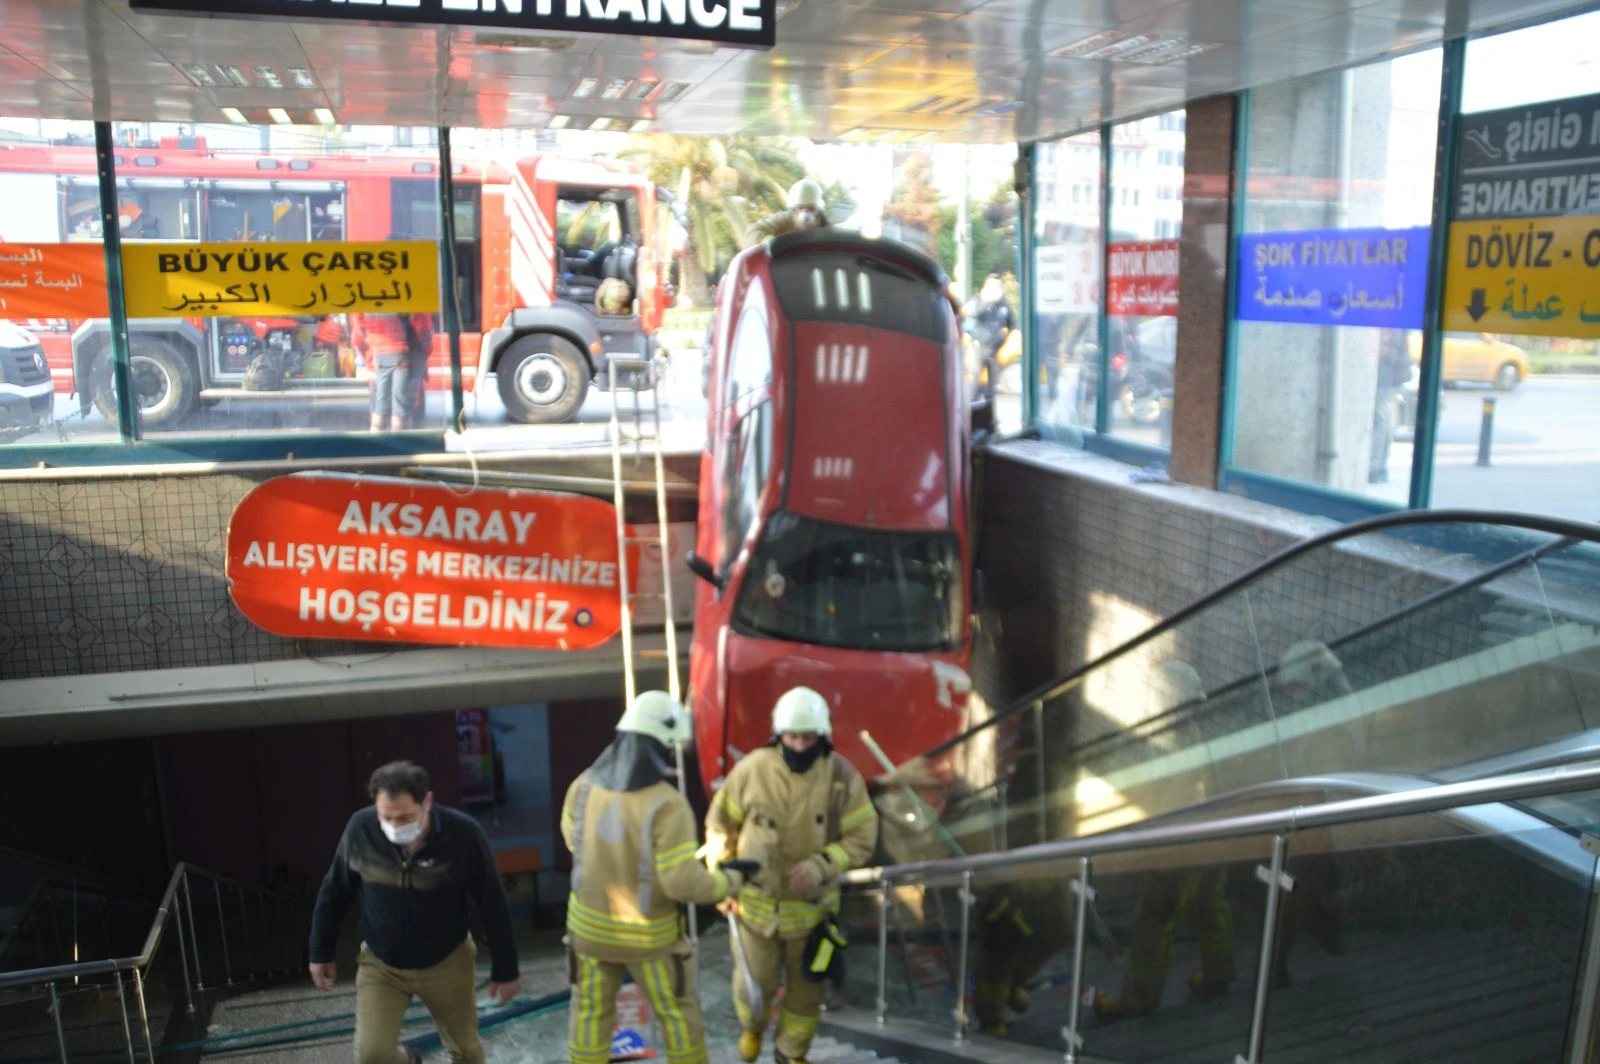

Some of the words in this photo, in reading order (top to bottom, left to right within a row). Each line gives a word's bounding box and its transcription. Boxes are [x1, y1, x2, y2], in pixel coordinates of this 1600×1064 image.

[158, 248, 289, 273] BÜYÜK
[302, 250, 409, 277] ÇARŞI
[1255, 243, 1296, 272] ŞOK
[1301, 234, 1409, 266] FİYATLAR
[1466, 222, 1554, 269] DÖVİZ
[162, 282, 271, 311] الكبير
[292, 280, 412, 308] البازار
[1501, 277, 1565, 321] عملة
[338, 500, 536, 545] AKSARAY
[243, 540, 408, 580] ALIŞVERİŞ
[416, 550, 617, 588] MERKEZİNİZE
[299, 586, 570, 632] HOŞGELDİNİZ
